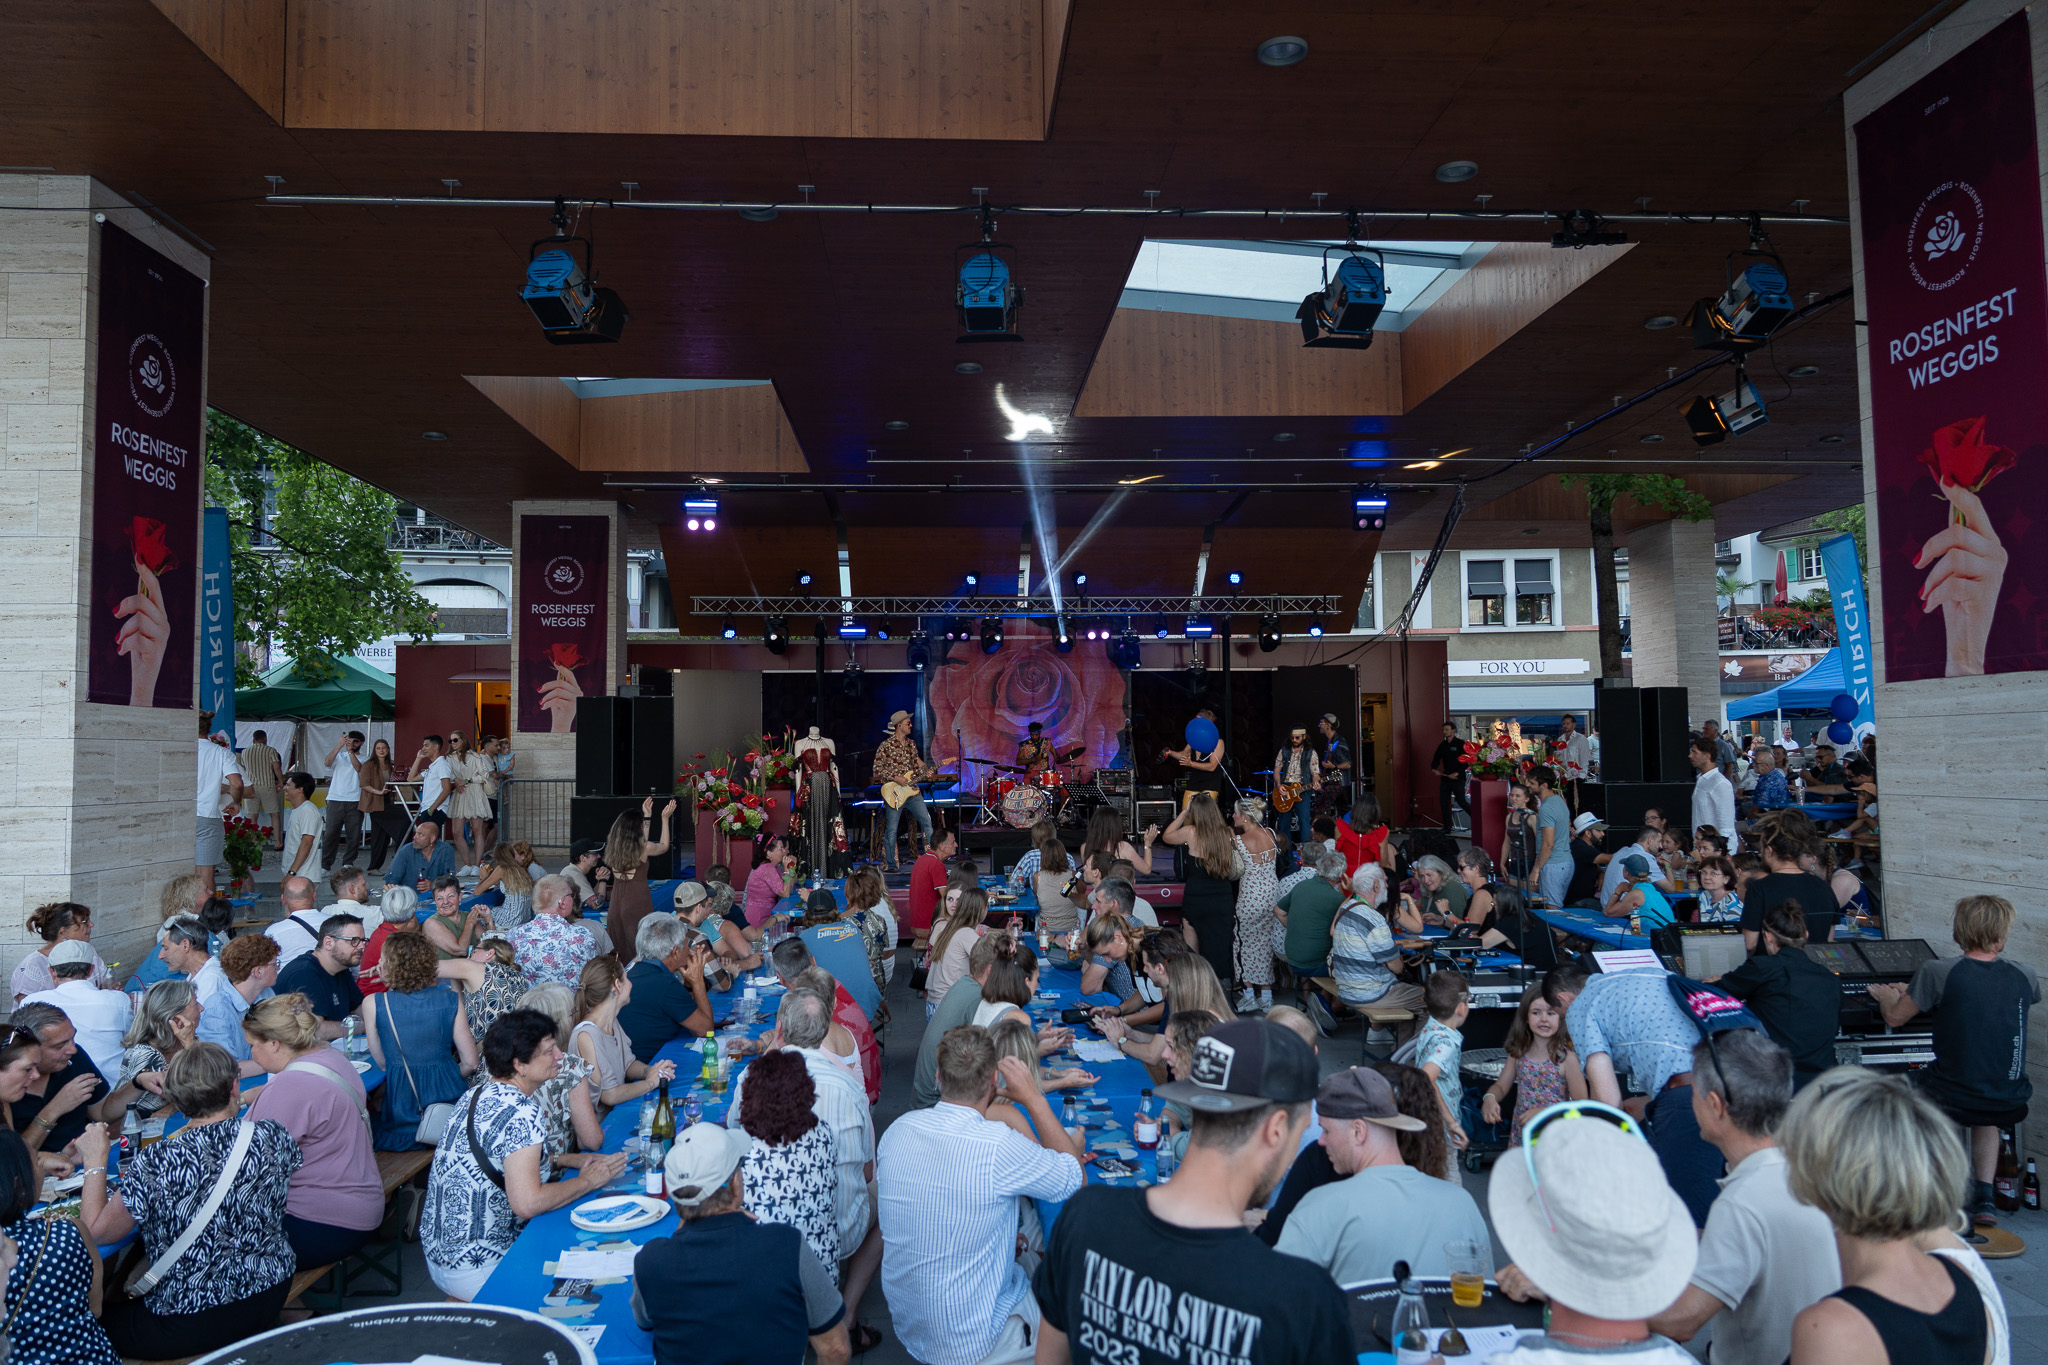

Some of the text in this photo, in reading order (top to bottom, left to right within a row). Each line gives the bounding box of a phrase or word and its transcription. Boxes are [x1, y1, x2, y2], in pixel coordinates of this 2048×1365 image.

[1907, 181, 1953, 253] ROSENFEST WEGGIS
[1960, 182, 1984, 260] ROSENFEST WEGGIS
[1909, 262, 1966, 290] ROSENFEST WEGGIS
[1890, 288, 2018, 364] ROSENFEST
[1908, 335, 1999, 390] WEGGIS
[111, 422, 188, 468] ROSENFEST
[124, 454, 176, 490] WEGGIS
[531, 604, 596, 614] ROSENFEST
[541, 617, 586, 627] WEGGIS
[1480, 662, 1545, 674] FOR YOU
[817, 927, 858, 939] billabong
[2009, 1035, 2020, 1080] alfacom.ch
[1084, 1248, 1262, 1358] TAYLOR SWIFT
[1357, 1288, 1402, 1301] rlebnis.
[350, 1315, 497, 1328] Das Getränke Erlebnis.
[1080, 1320, 1141, 1365] 2023
[1081, 1290, 1118, 1333] THE
[1122, 1315, 1181, 1360] ERAS
